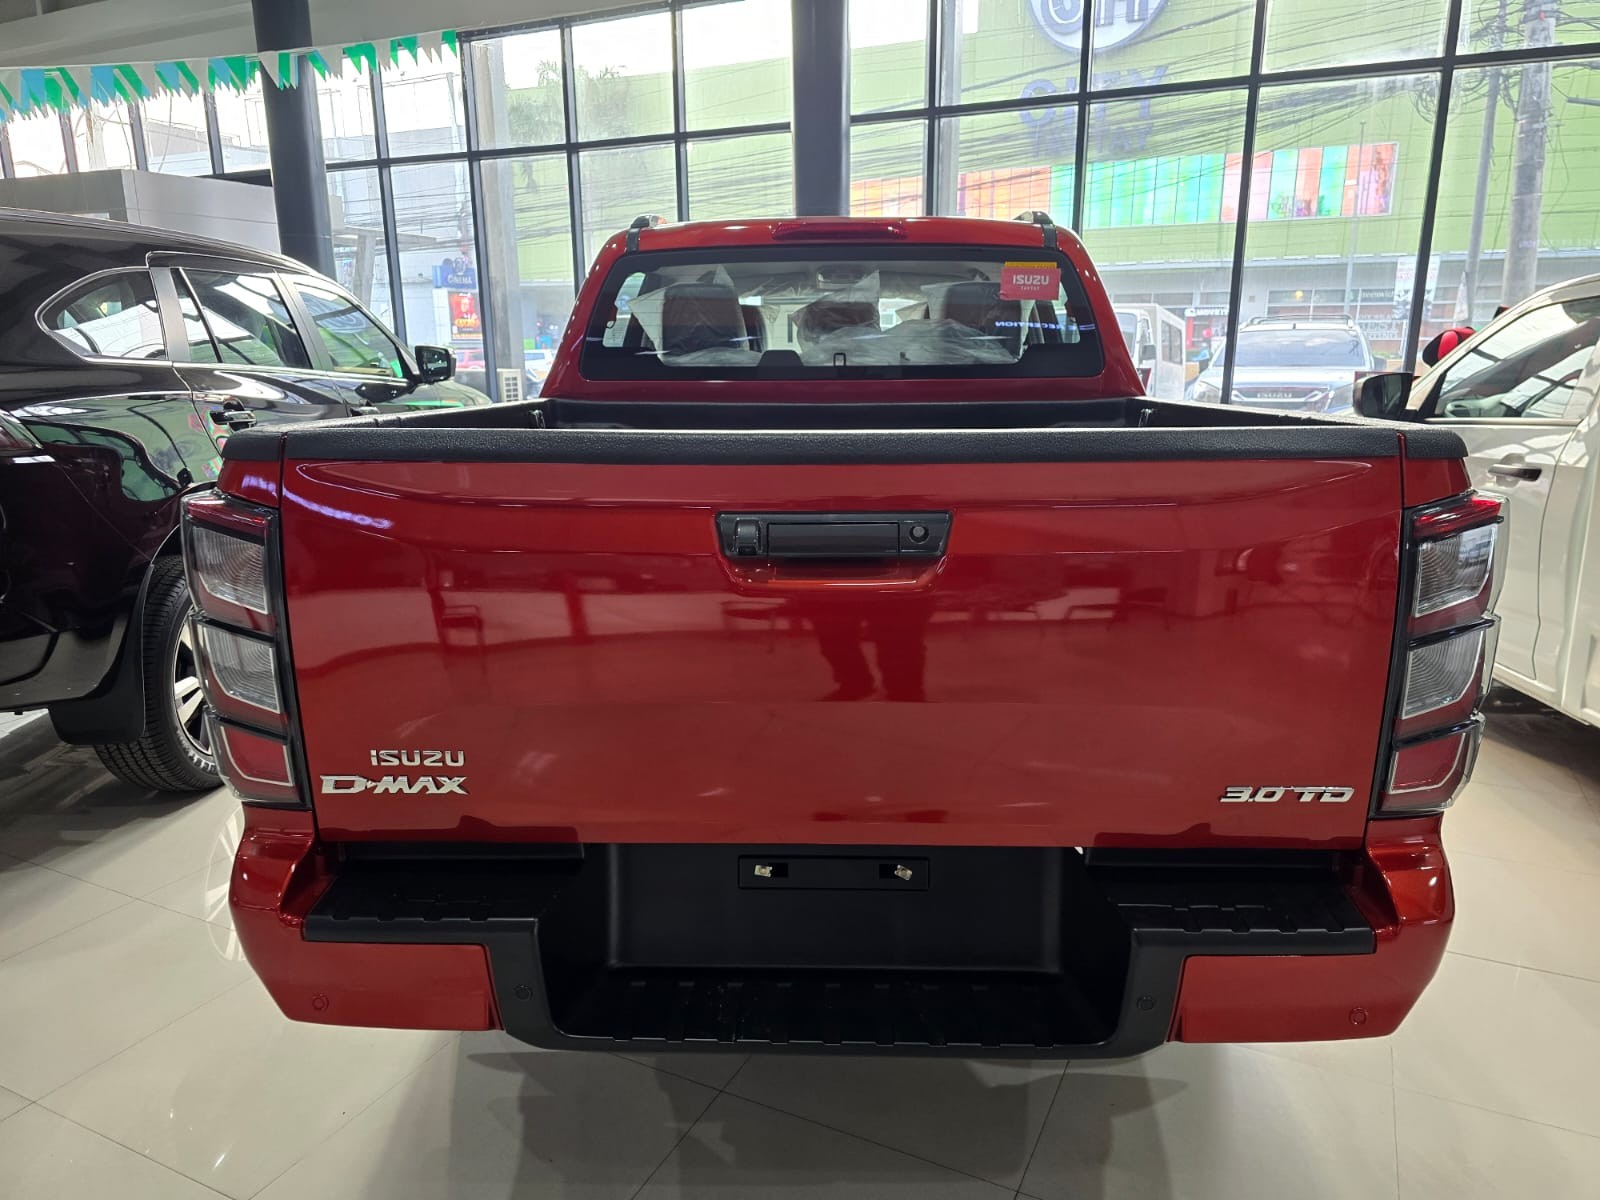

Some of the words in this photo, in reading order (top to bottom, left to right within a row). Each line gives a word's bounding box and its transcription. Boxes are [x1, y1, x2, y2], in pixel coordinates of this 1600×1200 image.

[1019, 65, 1168, 127] CITY
[447, 274, 473, 284] CINEMA
[1012, 274, 1049, 285] ISUZU
[370, 749, 465, 766] ISUZU
[320, 775, 469, 795] D-MAX
[1220, 786, 1287, 802] 3.0
[1293, 786, 1355, 802] TD
